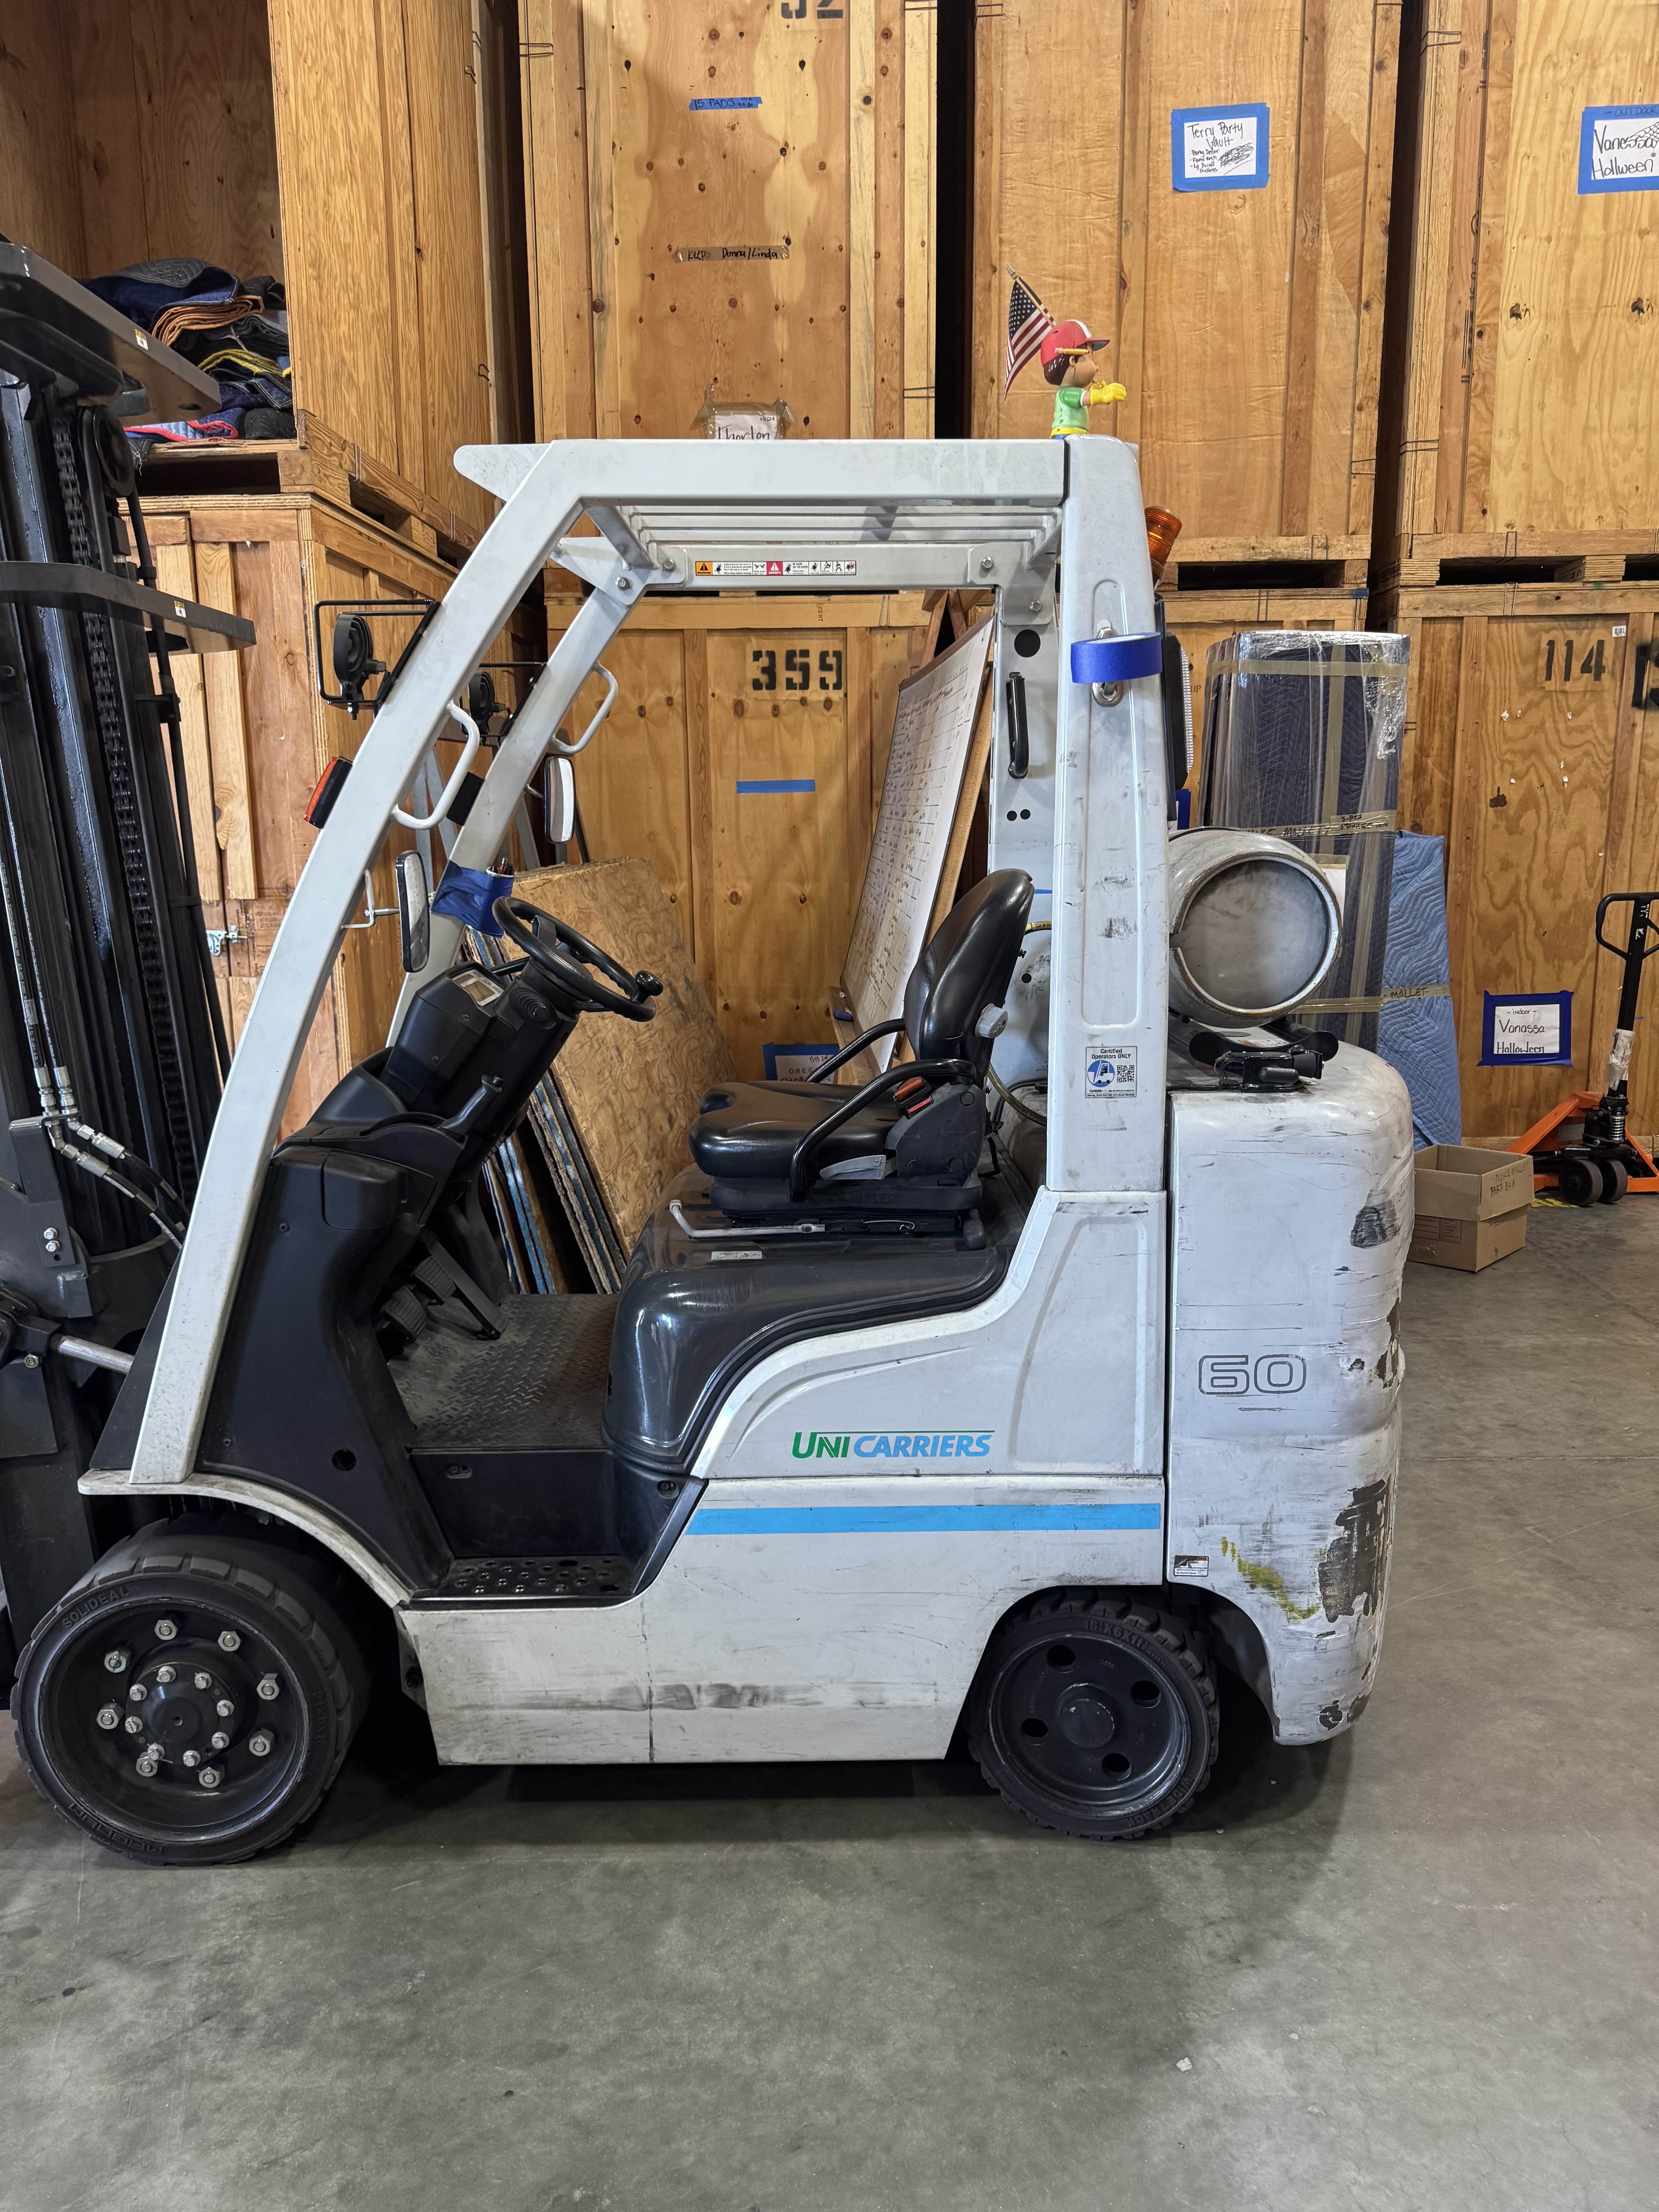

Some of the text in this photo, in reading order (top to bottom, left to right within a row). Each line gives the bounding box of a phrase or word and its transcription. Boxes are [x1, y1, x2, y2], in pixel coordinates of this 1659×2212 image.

[709, 98, 735, 109] PADS
[1187, 122, 1243, 139] Terry Party
[1594, 125, 1656, 154] Vanessa
[752, 649, 842, 690] 359
[1545, 639, 1606, 682] 114
[1199, 1354, 1307, 1395] 60
[62, 1585, 130, 1628] SOLIDEAL
